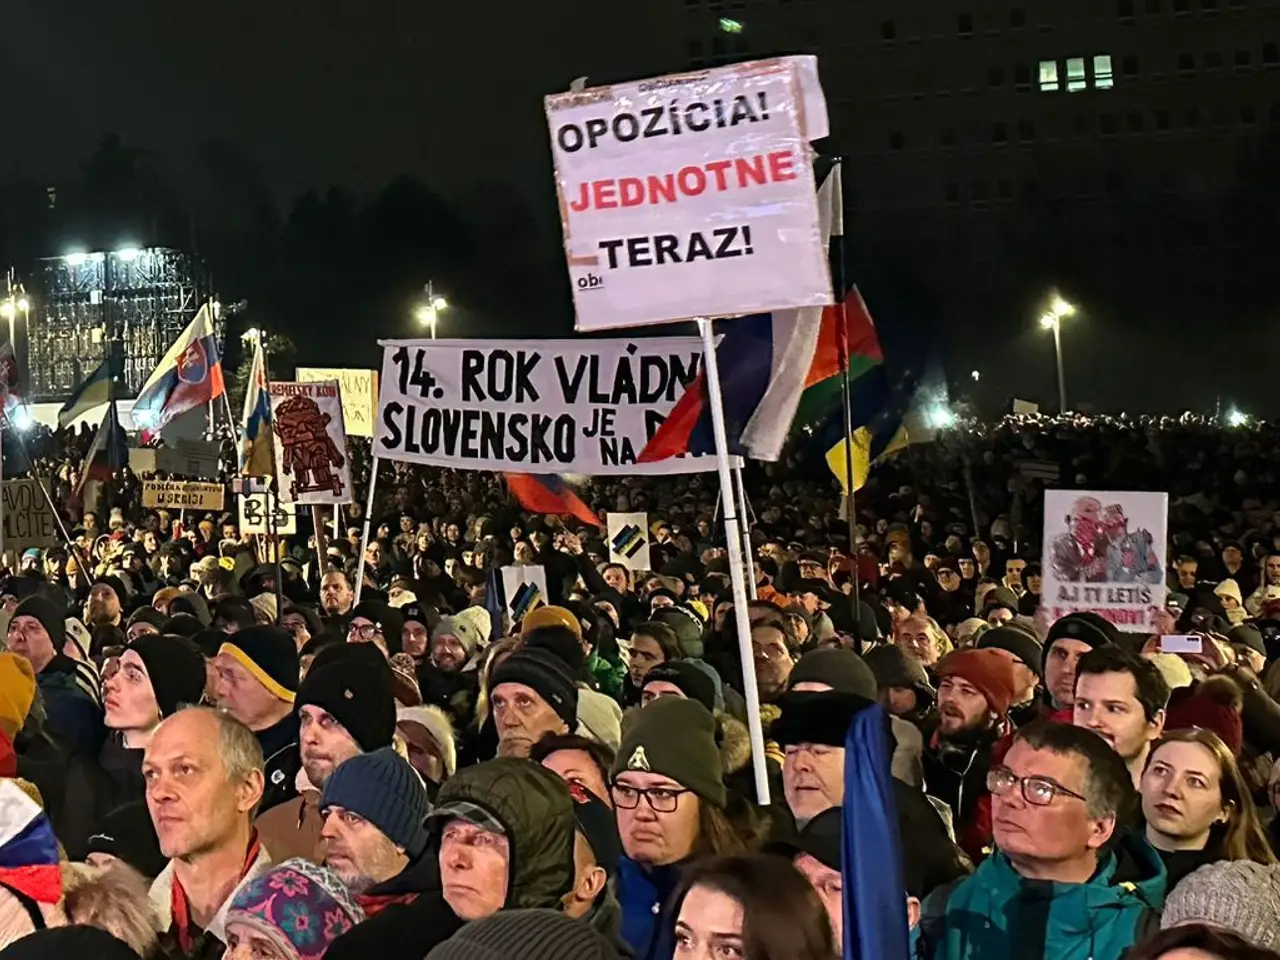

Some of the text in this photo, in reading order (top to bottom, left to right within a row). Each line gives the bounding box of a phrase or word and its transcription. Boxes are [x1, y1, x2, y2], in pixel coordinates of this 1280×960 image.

[557, 91, 770, 153] OPOZÍCIA!
[570, 150, 797, 212] JEDNOTNE
[598, 225, 755, 269] TERAZ!
[578, 272, 603, 288] ob
[392, 346, 444, 399] 14.
[461, 349, 541, 404] ROK
[553, 342, 706, 405] VLÁDN
[379, 401, 576, 465] SLOVENSKO
[582, 408, 617, 438] JE
[600, 436, 638, 466] NA
[2, 484, 46, 511] AVDU
